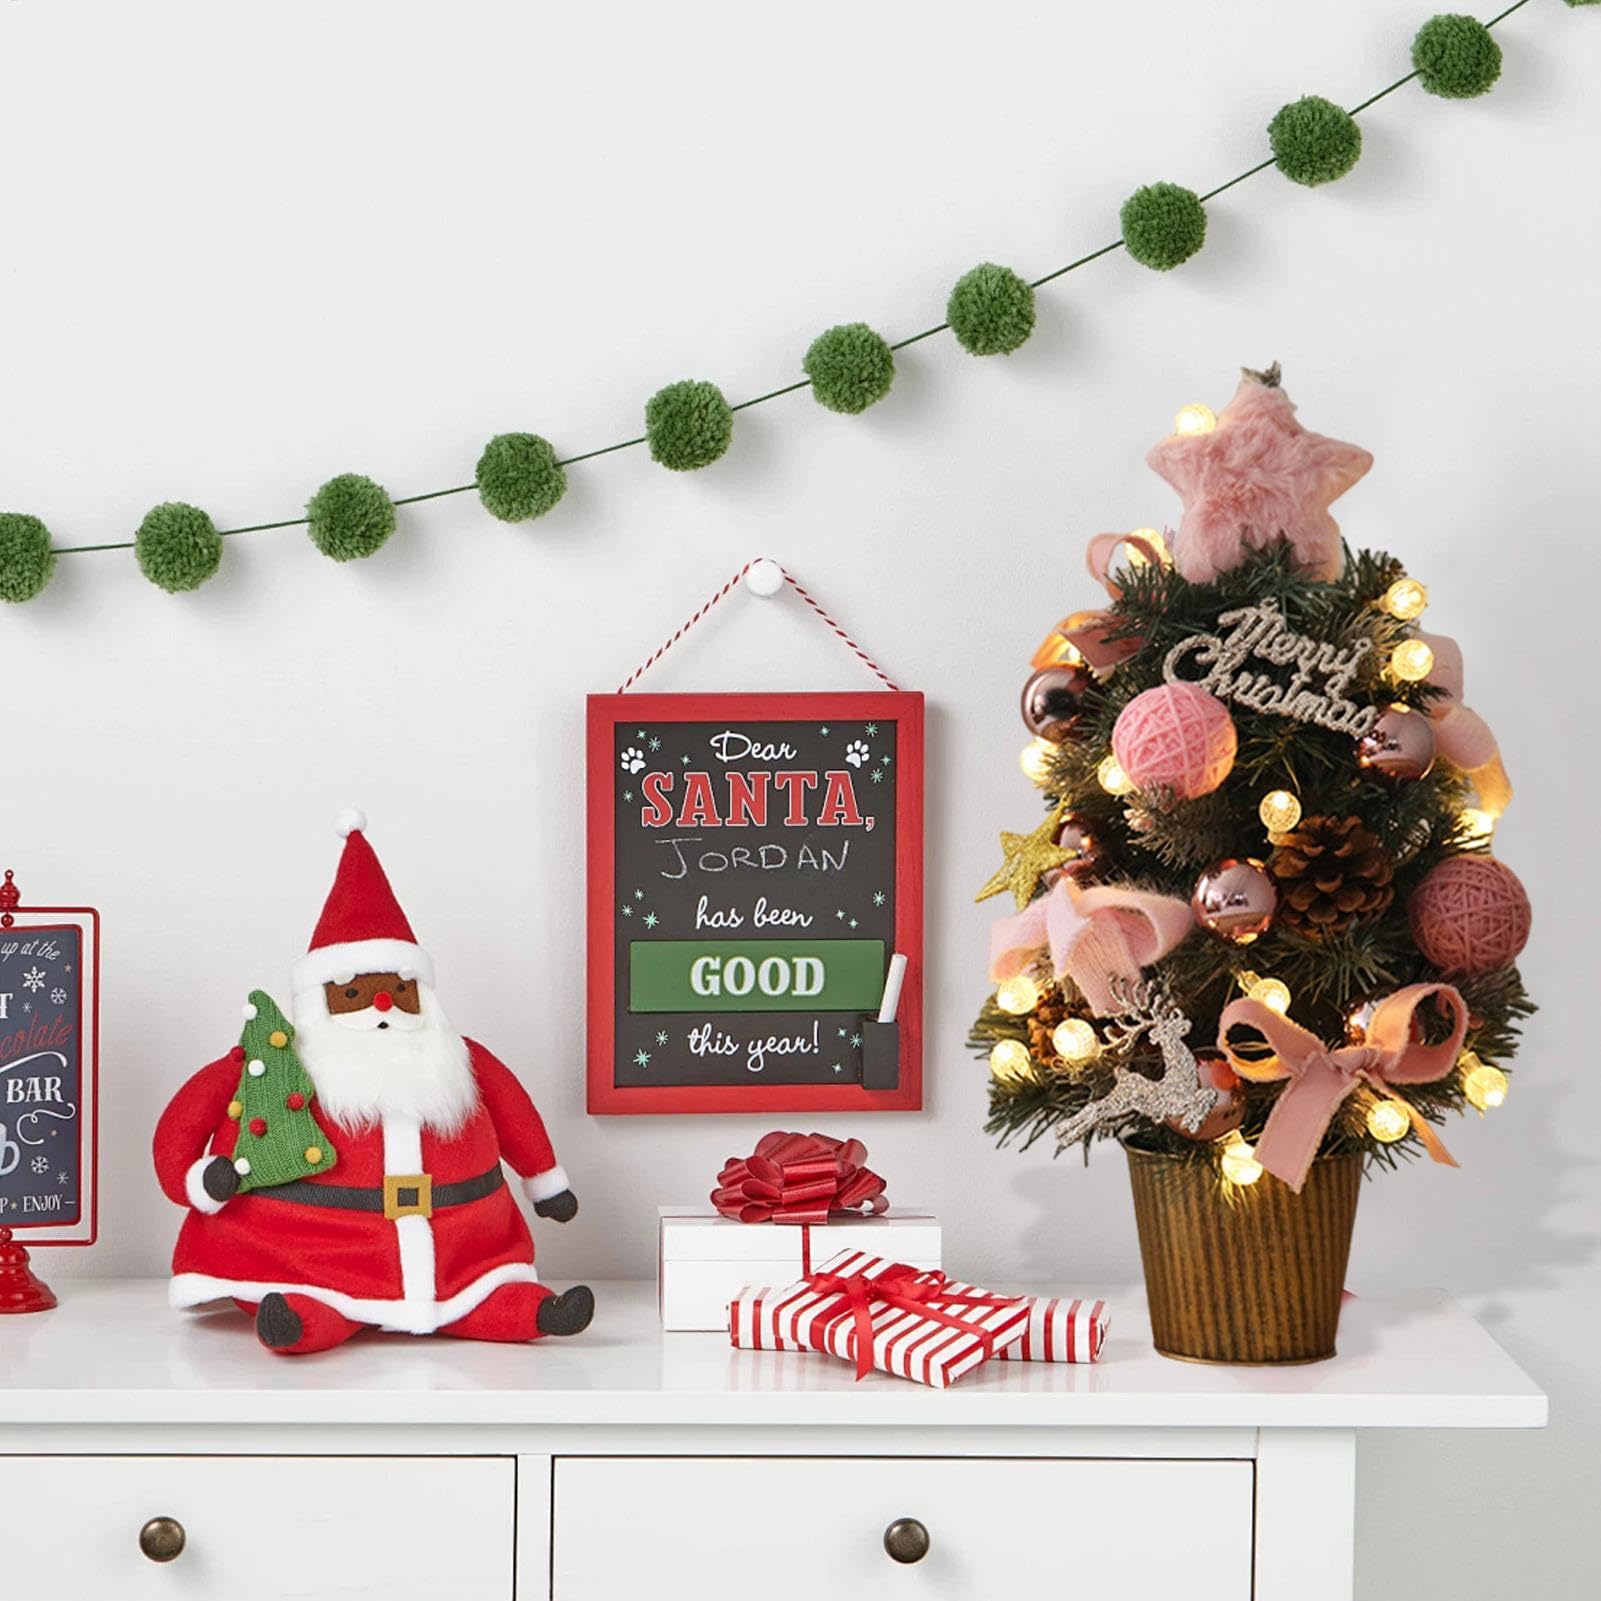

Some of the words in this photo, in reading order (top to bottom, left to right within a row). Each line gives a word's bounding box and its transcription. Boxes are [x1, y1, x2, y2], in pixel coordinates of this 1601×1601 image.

[1217, 597, 1373, 699] Merry
[1162, 633, 1379, 738] Christmas
[710, 730, 797, 763] Dear
[641, 770, 876, 832] SANTA,
[654, 836, 850, 879] JORDAN
[695, 895, 744, 930] has
[753, 896, 813, 929] been
[20, 939, 40, 956] at
[36, 940, 61, 961] the
[690, 955, 825, 997] GOOD
[687, 1020, 739, 1057] this
[747, 1020, 821, 1072] year!
[6, 1076, 64, 1104] BAR
